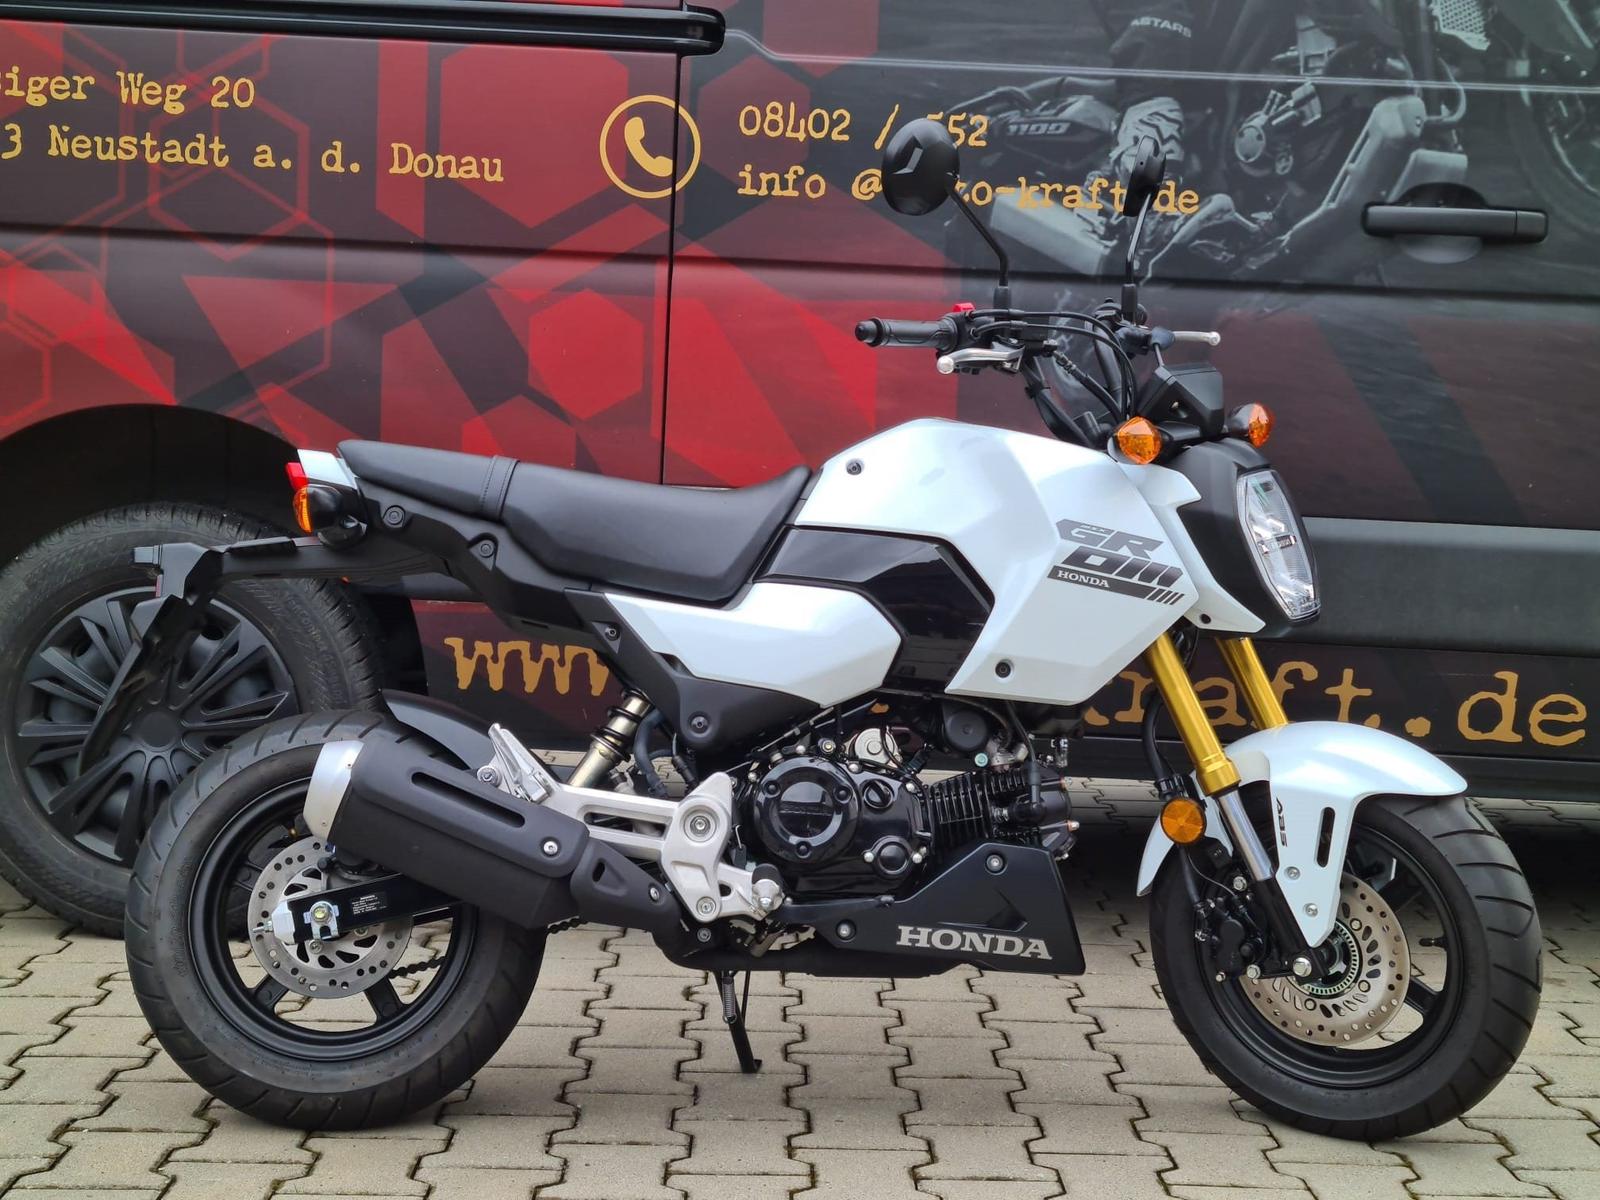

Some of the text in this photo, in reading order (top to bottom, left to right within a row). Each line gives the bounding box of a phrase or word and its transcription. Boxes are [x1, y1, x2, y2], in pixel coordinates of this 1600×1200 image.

[0, 65, 257, 116] iger Weg 20
[738, 101, 989, 150] 08402 / 52
[48, 124, 230, 168] Neustadt
[254, 143, 292, 171] a.
[321, 140, 361, 174] d.
[389, 143, 504, 183] Donau
[737, 164, 827, 201] info
[1056, 570, 1111, 589] HONDA
[896, 925, 1053, 960] HONDA
